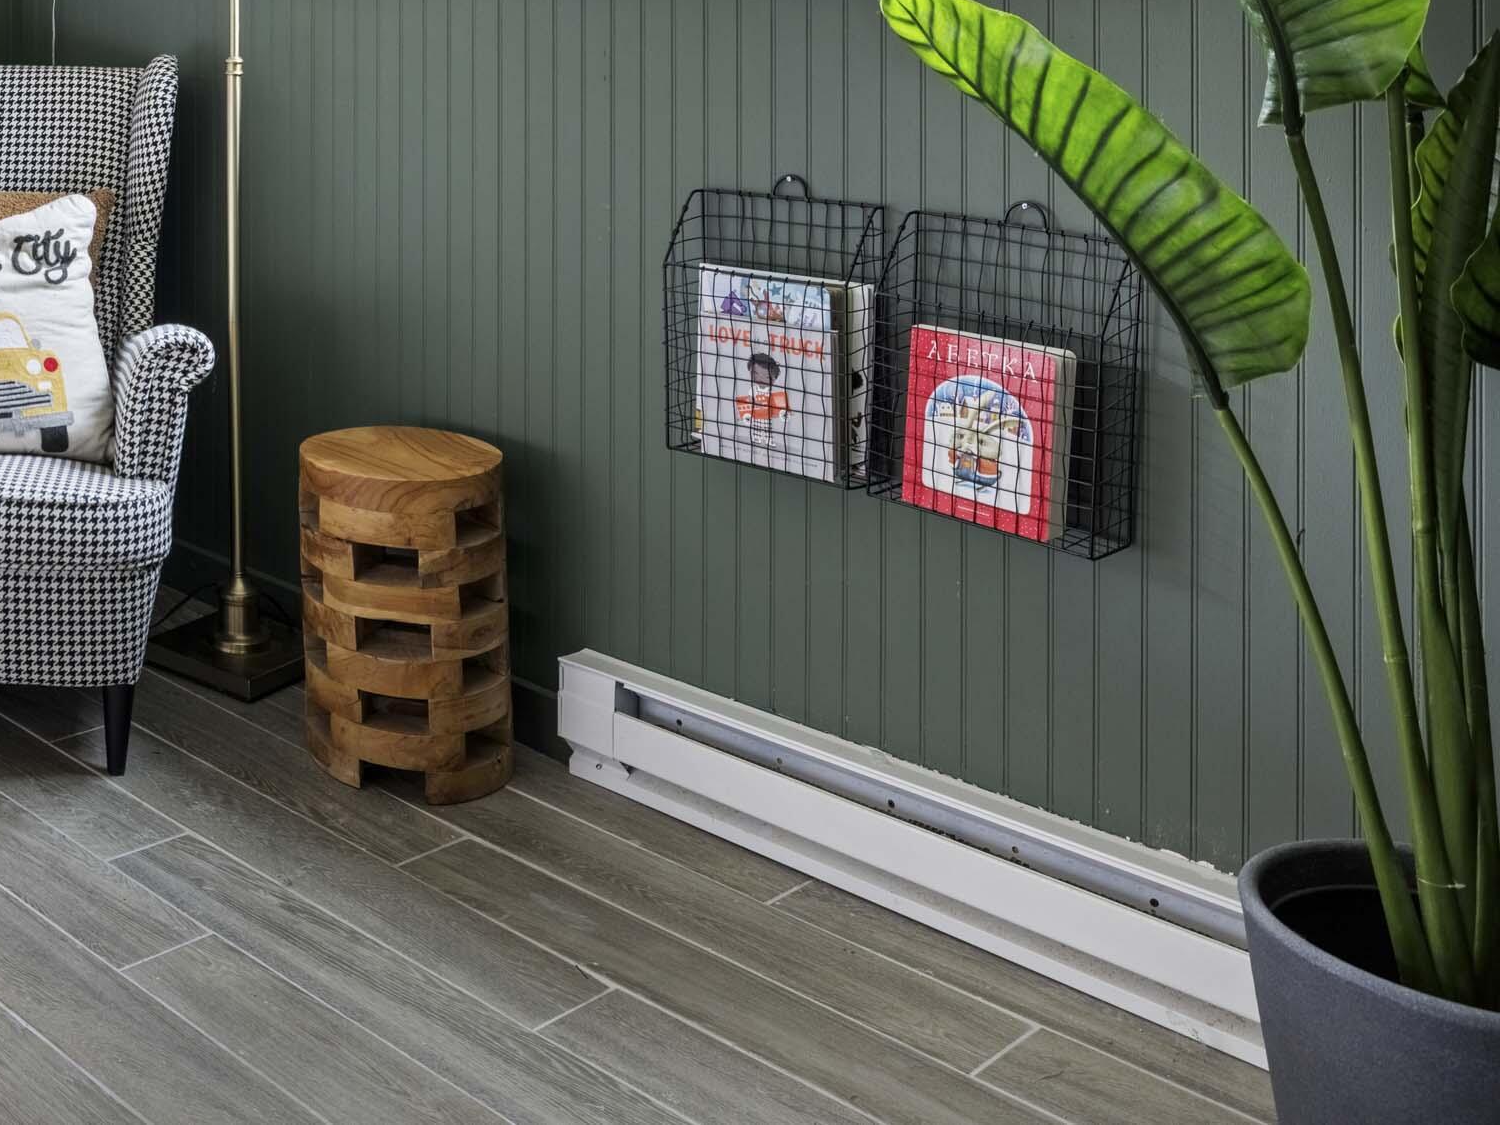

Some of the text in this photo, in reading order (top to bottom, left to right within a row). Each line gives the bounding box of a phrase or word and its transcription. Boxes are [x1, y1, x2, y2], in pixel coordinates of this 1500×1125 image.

[11, 227, 78, 285] City
[708, 324, 827, 363] LOVE TRUCK
